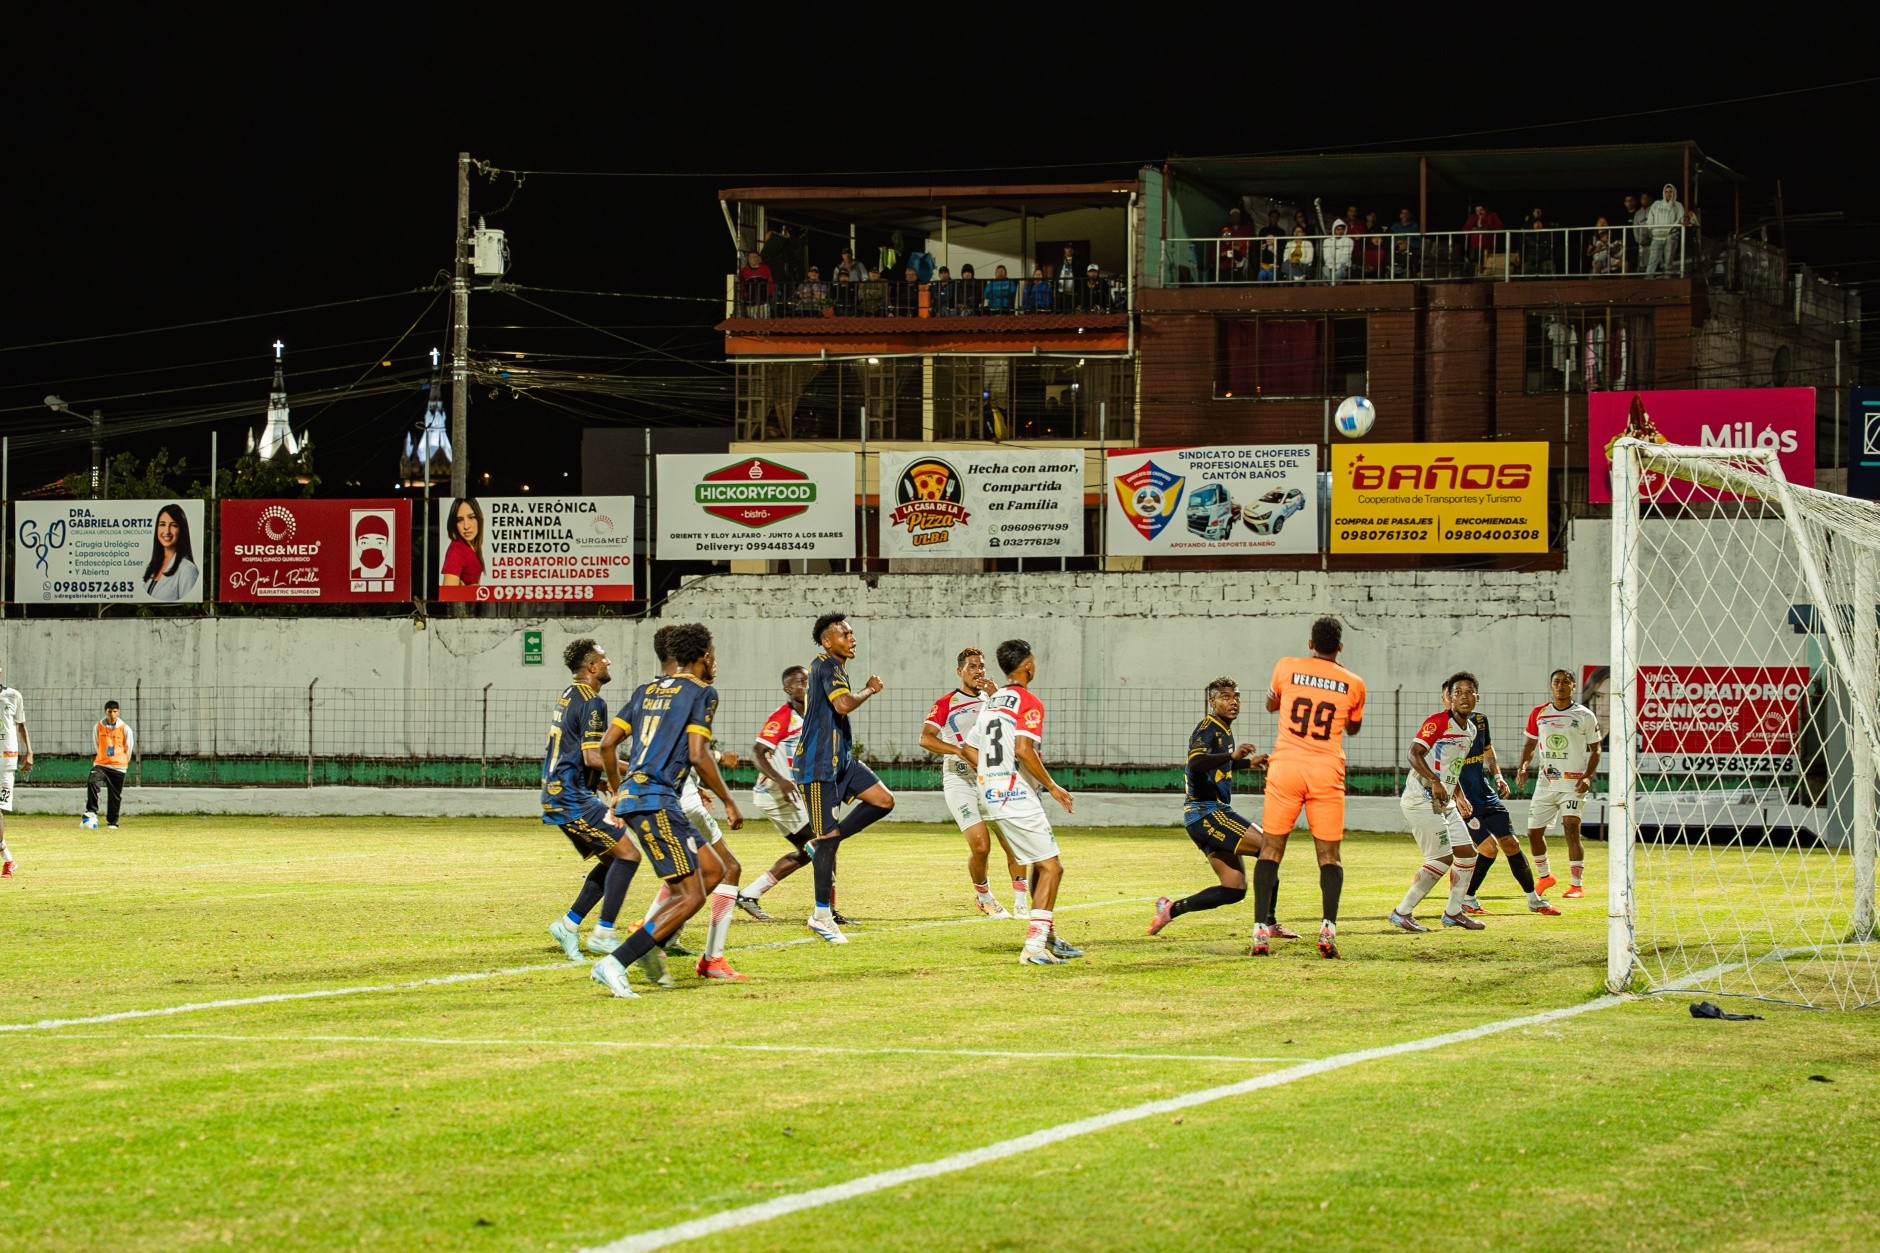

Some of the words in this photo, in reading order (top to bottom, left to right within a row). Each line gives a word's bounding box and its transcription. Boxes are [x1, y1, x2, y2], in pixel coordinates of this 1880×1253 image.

[1178, 451, 1235, 459] SINDICATO
[1238, 450, 1251, 458] DE
[1255, 449, 1311, 458] CHOFERES
[968, 464, 1009, 474] Hecha
[1012, 465, 1036, 473] con
[1038, 464, 1079, 474] amor,
[1190, 461, 1276, 470] PROFESIONALES
[1279, 460, 1299, 468] DEL
[1202, 470, 1247, 480] CANTÓN
[1249, 469, 1286, 479] BAÑOS
[1352, 456, 1532, 490] BAÑOS
[700, 486, 810, 499] HICKORYFOOD
[982, 481, 1062, 494] Compartida
[989, 502, 1004, 510] en
[1006, 500, 1058, 510] Familia
[1358, 494, 1410, 505] Cooperativa
[1412, 495, 1423, 503] de
[1424, 494, 1477, 505] Transportes
[1479, 496, 1485, 504] y
[1486, 494, 1521, 503] Turismo
[492, 503, 524, 513] DRA.
[528, 500, 597, 513] VERÓNICA
[902, 506, 914, 514] LA
[914, 503, 935, 511] CASA
[948, 506, 958, 514] LA
[70, 509, 94, 518] DRA.
[69, 519, 119, 528] GABRIELA
[122, 518, 152, 528] ORTIZ
[492, 516, 562, 526] FERNANDA
[907, 512, 954, 532] Pizza
[1001, 524, 1068, 532] 0960967499
[492, 529, 574, 540] VEINTIMILLA
[913, 531, 949, 546] ULBA
[1341, 530, 1428, 540] 0980761302
[1445, 530, 1540, 540] 0980400308
[104, 540, 139, 550] Urológica
[492, 542, 570, 553] VERDEZOTO
[696, 542, 743, 552] Delivery:
[746, 542, 815, 550] 0994483449
[75, 550, 129, 558] Laparoscópica
[75, 560, 121, 568] Endoscópica
[123, 559, 143, 567] Láser
[492, 556, 577, 567] LABORATORIO
[581, 556, 631, 566] CLINICO
[492, 569, 507, 579] DE
[510, 568, 610, 579] ESPECIALIDADES
[54, 582, 134, 592] 0980572683
[493, 586, 594, 599] 0995835258
[1292, 672, 1336, 693] VELASCO
[1645, 672, 1679, 683] ÚNICO
[1644, 682, 1801, 700] LABORATORIO
[1643, 703, 1722, 718] CLINICO
[1725, 707, 1739, 716] DE
[1288, 697, 1336, 740] 99
[1642, 721, 1739, 732] ESPECIALIDADES
[636, 716, 661, 766] 4
[986, 718, 1004, 767] 3
[1682, 756, 1794, 772] 0995835258
[1566, 800, 1578, 810] 30
